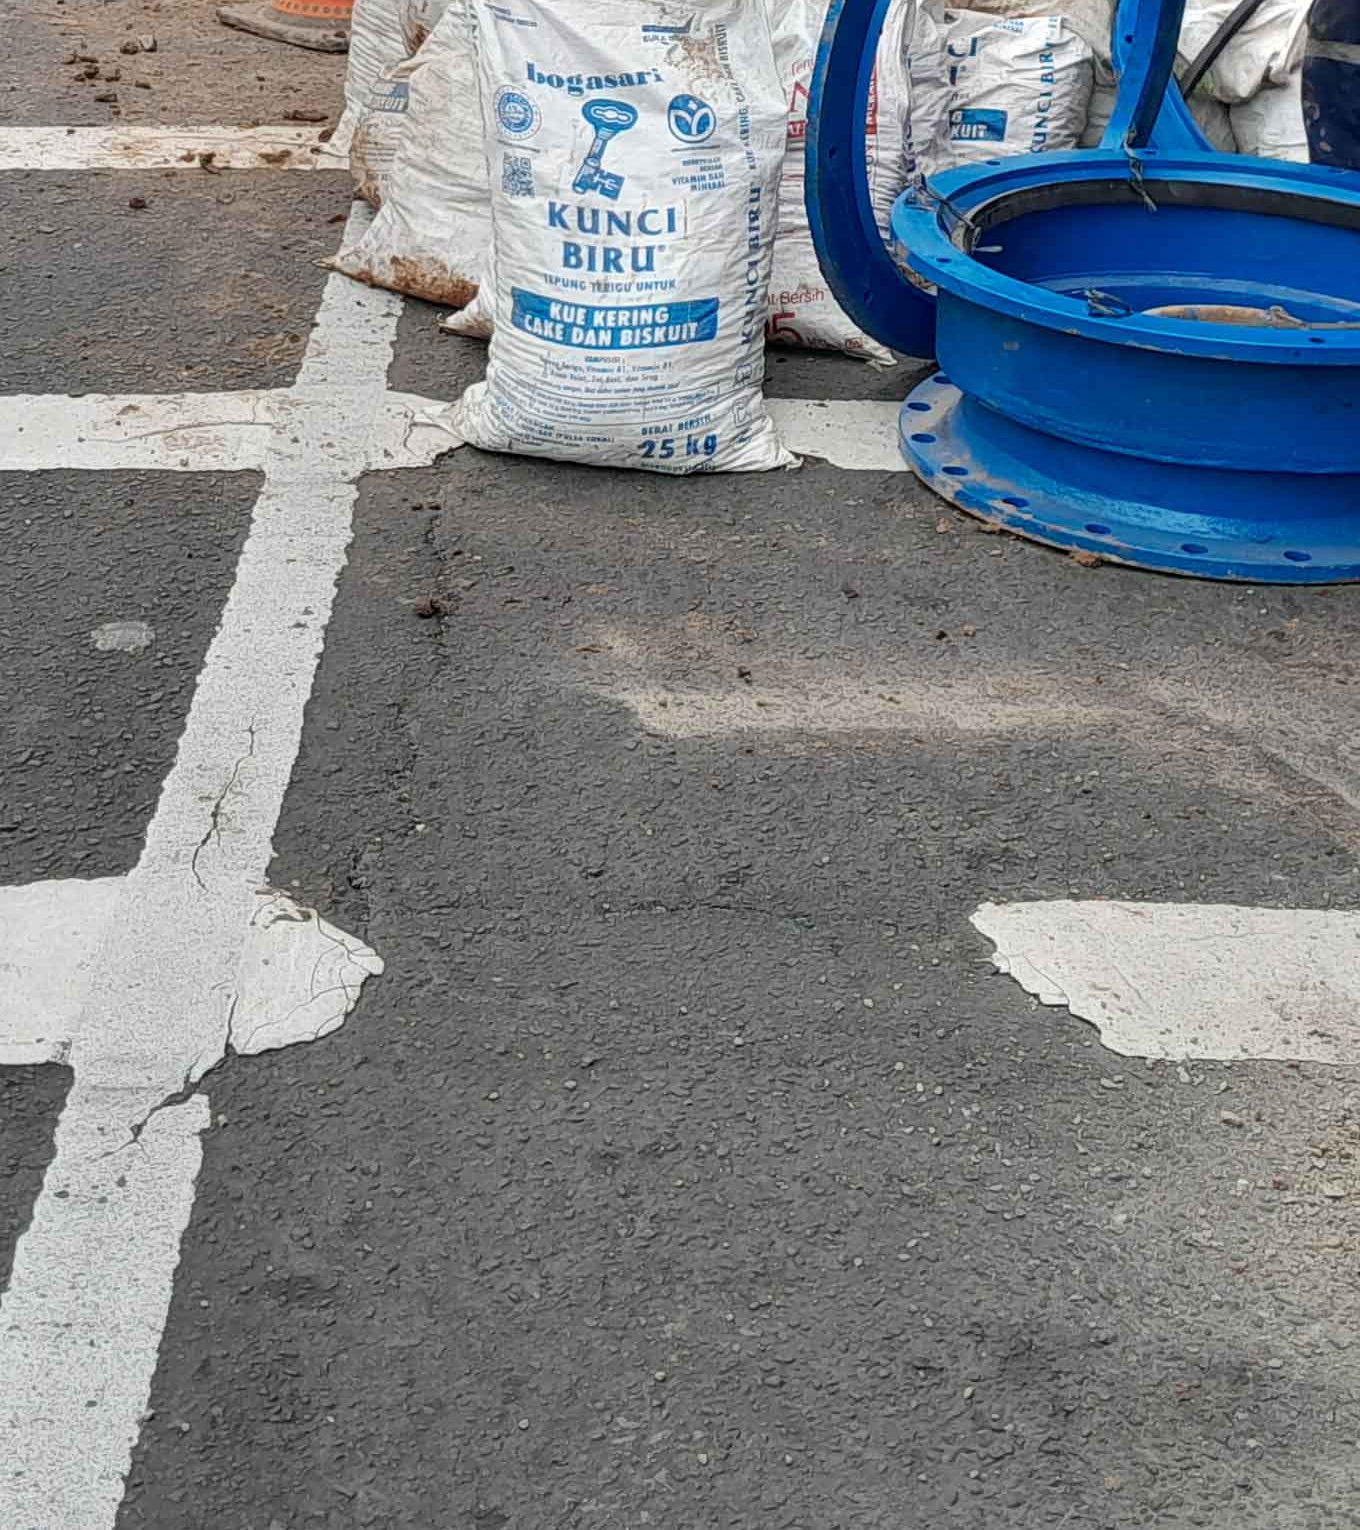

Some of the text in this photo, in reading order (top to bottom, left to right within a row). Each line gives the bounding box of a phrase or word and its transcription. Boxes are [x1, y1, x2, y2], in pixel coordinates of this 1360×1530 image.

[526, 60, 665, 97] bogasari
[548, 201, 677, 237] KUNCI
[562, 241, 658, 274] BIRU
[741, 186, 762, 346] KUNCI BIRU
[544, 273, 677, 294] TEPUNG TERIGU UNTUK
[781, 288, 825, 304] Bersih
[549, 301, 670, 327] KUE KERING
[771, 312, 802, 344] 5
[523, 314, 699, 348] CAKE DAN BISKUIT
[641, 424, 673, 436] BERAT
[637, 434, 719, 459] 25 kg
